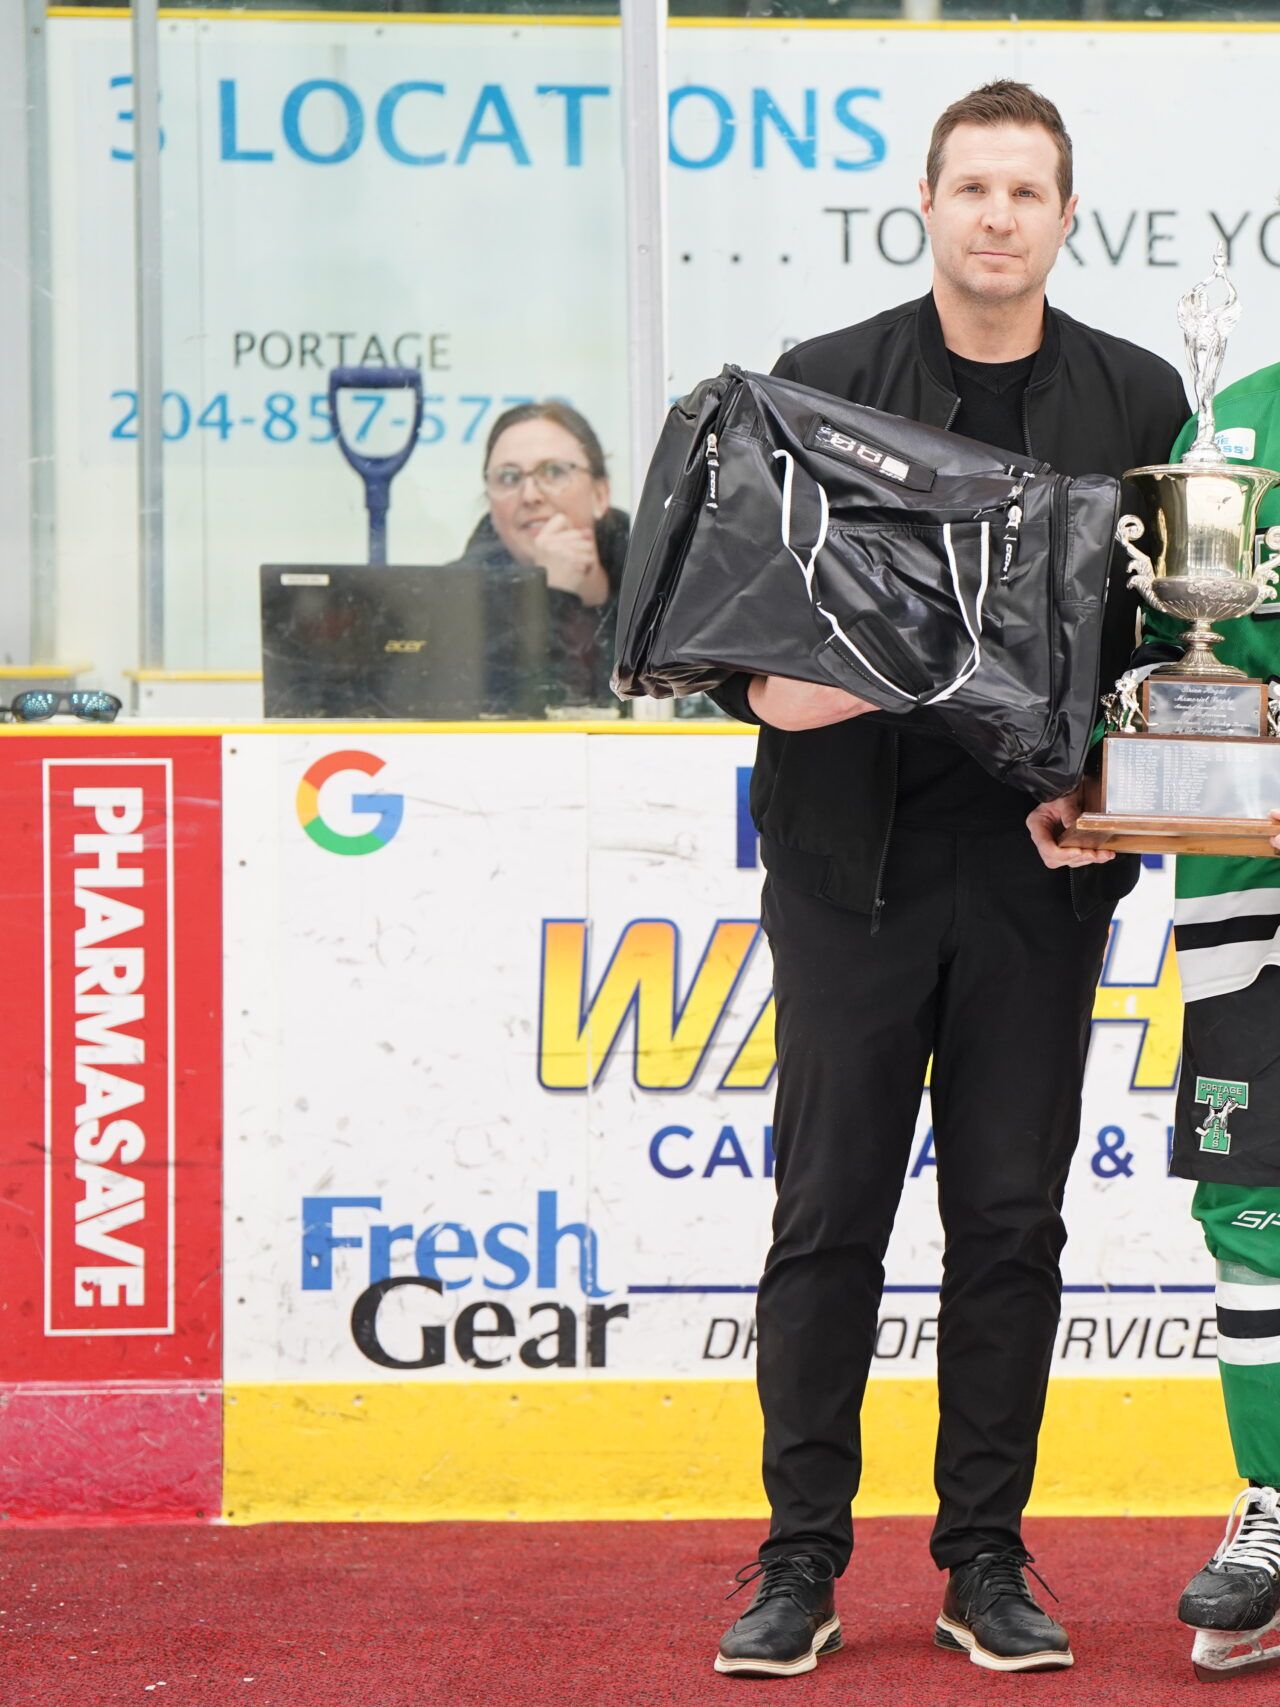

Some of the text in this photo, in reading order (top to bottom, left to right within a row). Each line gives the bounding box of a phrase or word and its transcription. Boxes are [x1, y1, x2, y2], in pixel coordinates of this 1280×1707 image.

[219, 79, 886, 171] LOCATONS
[824, 208, 926, 265] TO
[234, 332, 451, 369] PORTAGE
[385, 639, 426, 653] acer
[73, 787, 146, 1307] PHARMASAVE
[1200, 1083, 1243, 1095] PORTAGE
[649, 1125, 774, 1179] CA
[1090, 1125, 1135, 1179] &
[301, 1190, 616, 1298] Fresh
[350, 1276, 629, 1370] Gear
